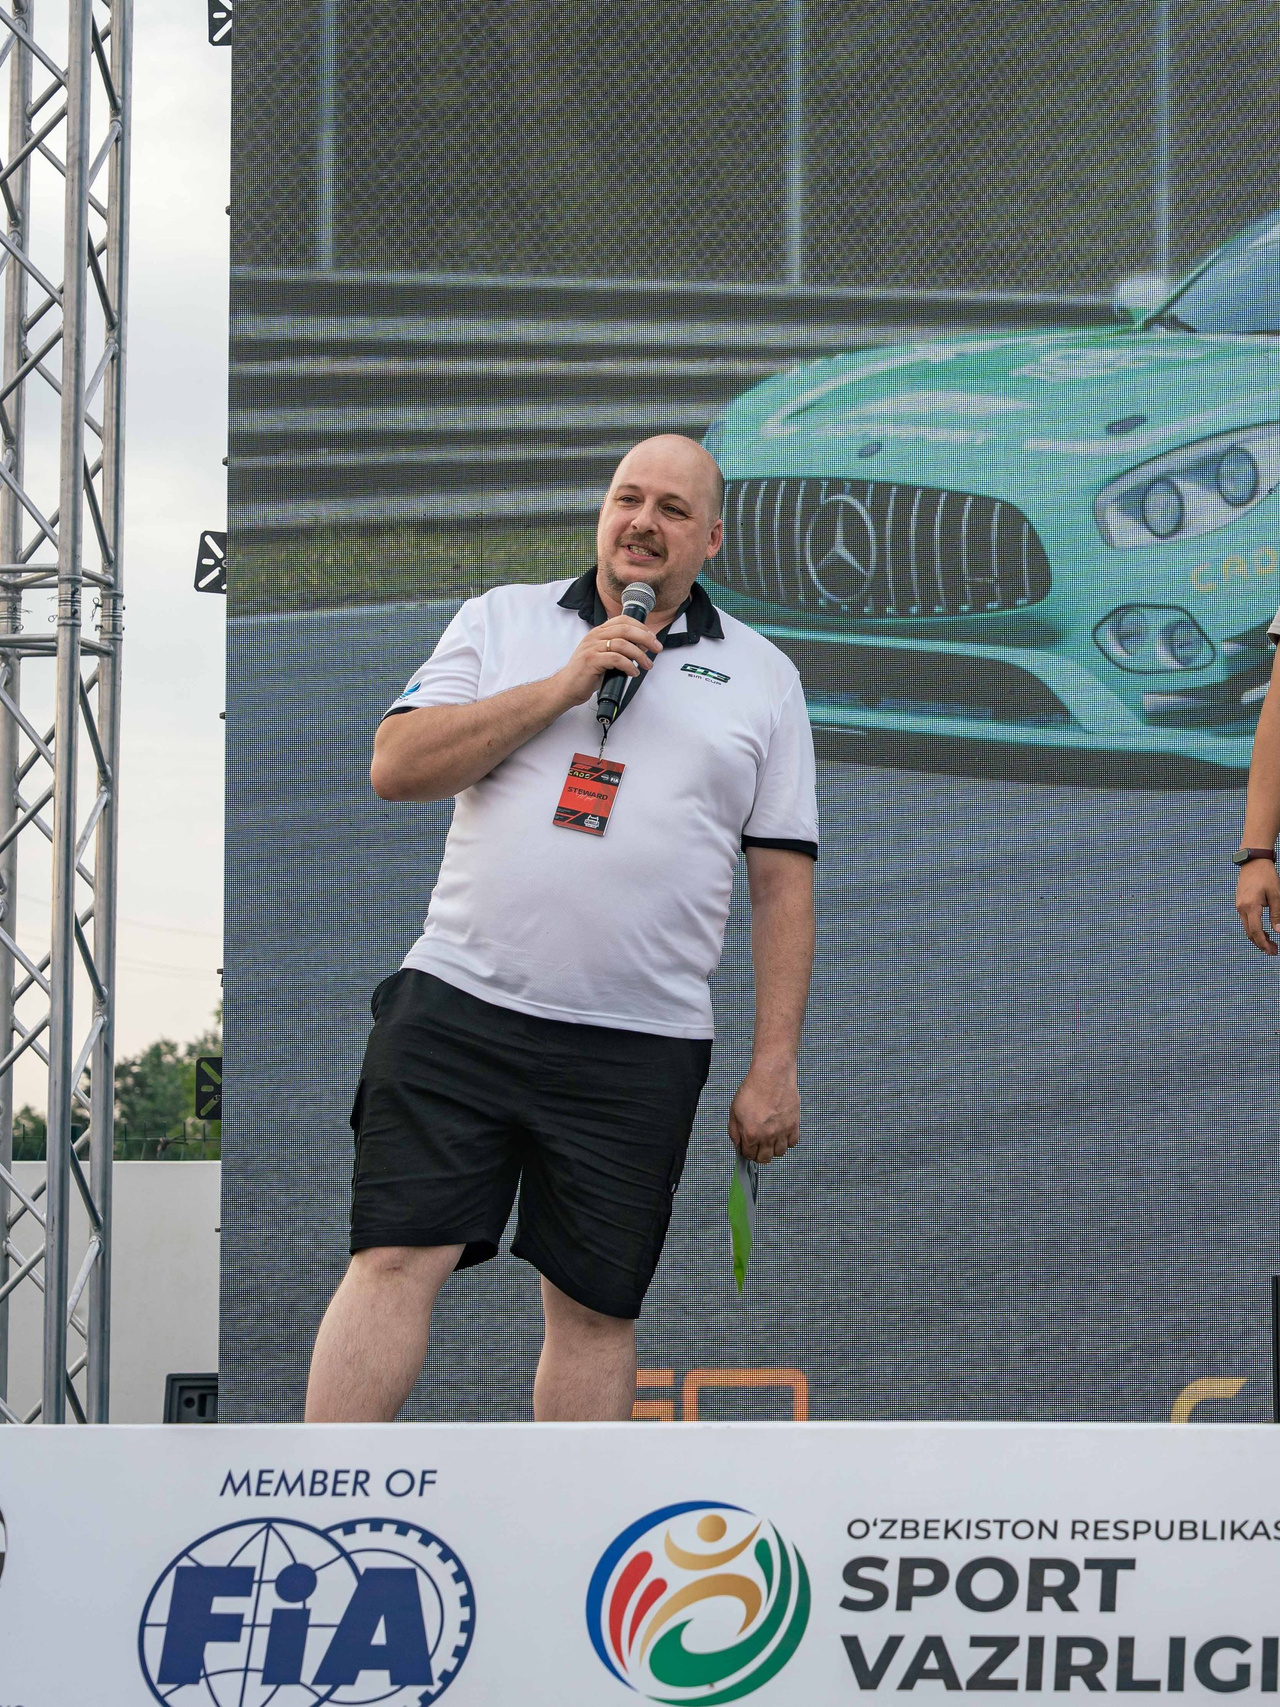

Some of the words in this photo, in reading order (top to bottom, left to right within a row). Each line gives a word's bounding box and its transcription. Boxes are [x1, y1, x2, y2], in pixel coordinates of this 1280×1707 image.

[567, 786, 609, 801] STEWARD
[219, 1469, 371, 1497] MEMBER
[385, 1468, 438, 1498] OF
[839, 1556, 1137, 1613] SPORT
[840, 1635, 1280, 1693] VAZIRLIGI
